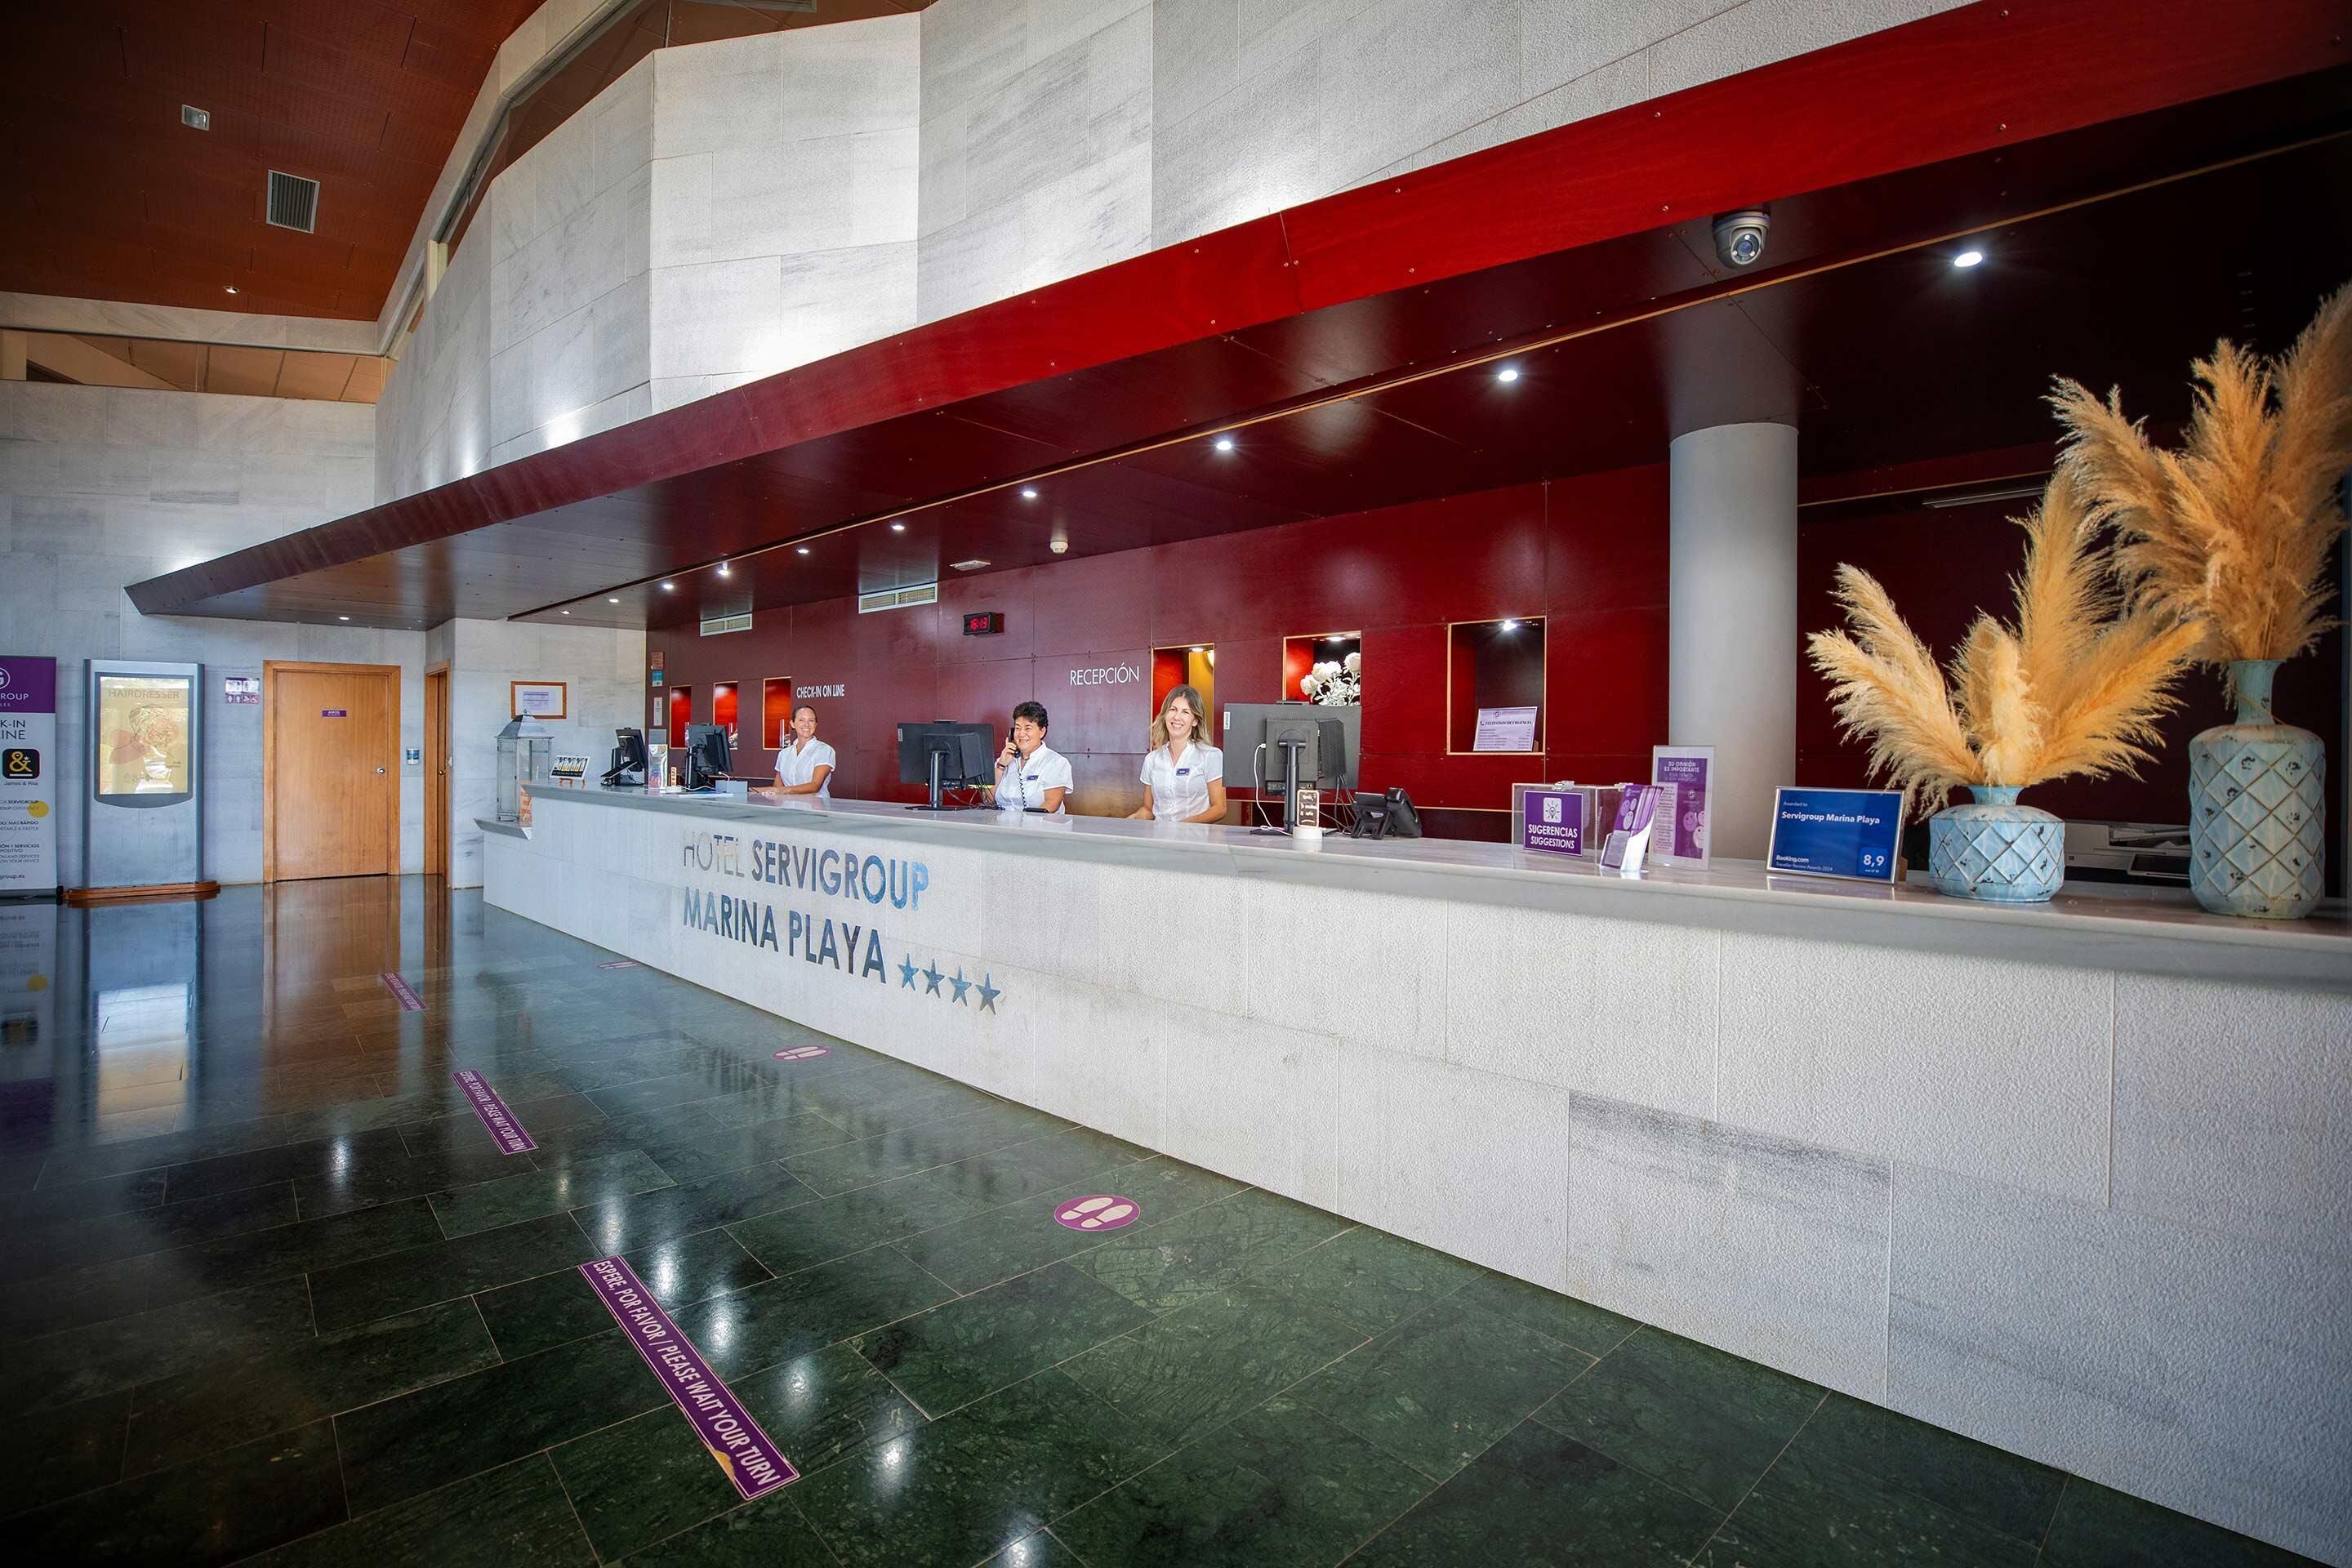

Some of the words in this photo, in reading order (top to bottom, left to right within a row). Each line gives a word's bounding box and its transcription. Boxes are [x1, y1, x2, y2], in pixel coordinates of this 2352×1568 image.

[1070, 662, 1140, 686] RECEPCIÓN
[108, 688, 180, 700] HAIRDRESSER
[796, 685, 822, 699] CHECK-IN
[822, 684, 832, 697] ON
[833, 684, 845, 697] LINE
[1781, 811, 1824, 822] Servigroup
[1826, 813, 1855, 822] Marina
[1856, 815, 1880, 826] Playa
[1528, 823, 1578, 838] SUGERENCIAS
[1530, 836, 1575, 849] SUGGESTIONS
[1776, 854, 1810, 863] Booking.com
[1863, 854, 1885, 867] 8,9
[683, 831, 745, 878] HOTEL
[751, 840, 929, 911] SERVIGROUP
[683, 886, 779, 952] MARINA
[789, 911, 886, 983] PLAYA
[472, 1089, 492, 1102] FAVOR
[483, 1104, 503, 1118] PLEASE
[491, 1116, 510, 1128] WAIT
[498, 1126, 519, 1140] YOUR
[507, 1138, 527, 1151] TURN
[593, 1260, 627, 1291] ESPERE,
[614, 1288, 642, 1309] POR
[628, 1307, 666, 1341] FAVOR
[657, 1345, 701, 1383] PLEASE
[685, 1380, 724, 1412] WAIT
[708, 1409, 751, 1450] YOUR
[736, 1446, 782, 1486] TURN
